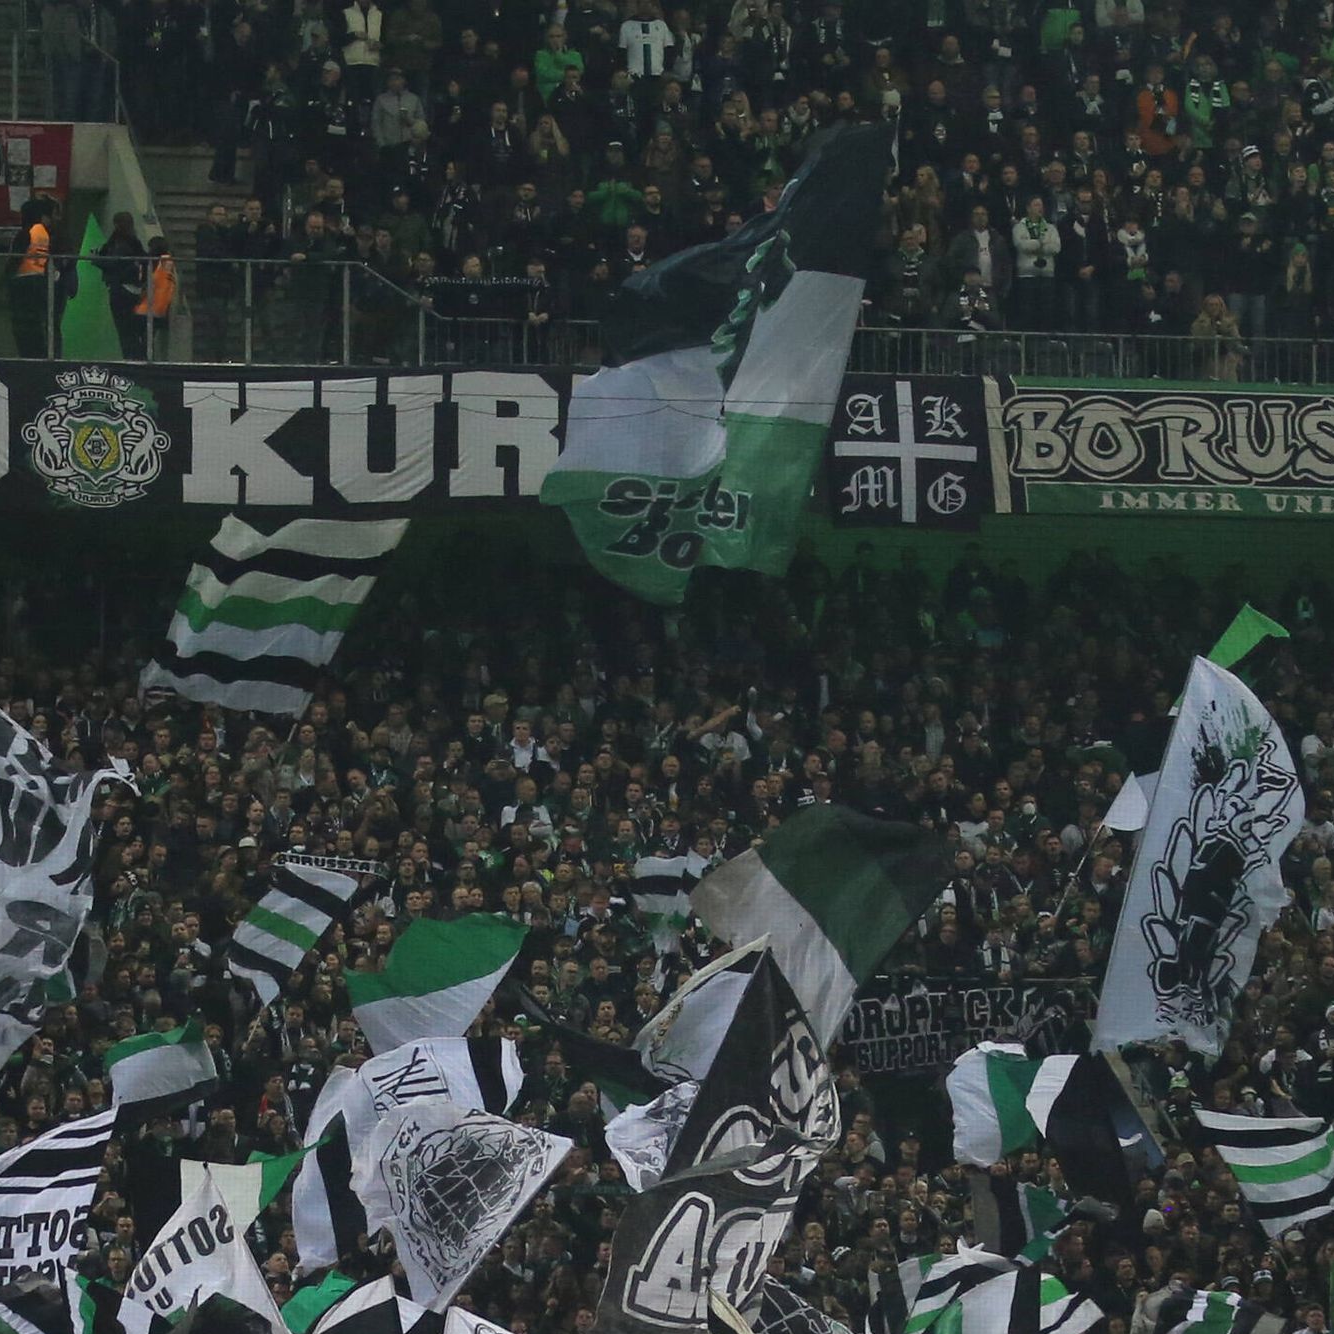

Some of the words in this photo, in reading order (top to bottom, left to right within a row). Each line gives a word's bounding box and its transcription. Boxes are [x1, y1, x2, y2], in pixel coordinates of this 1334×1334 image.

[181, 371, 579, 505] KUR
[845, 392, 890, 439] A
[920, 394, 971, 439] K
[1098, 489, 1244, 512] IMMER
